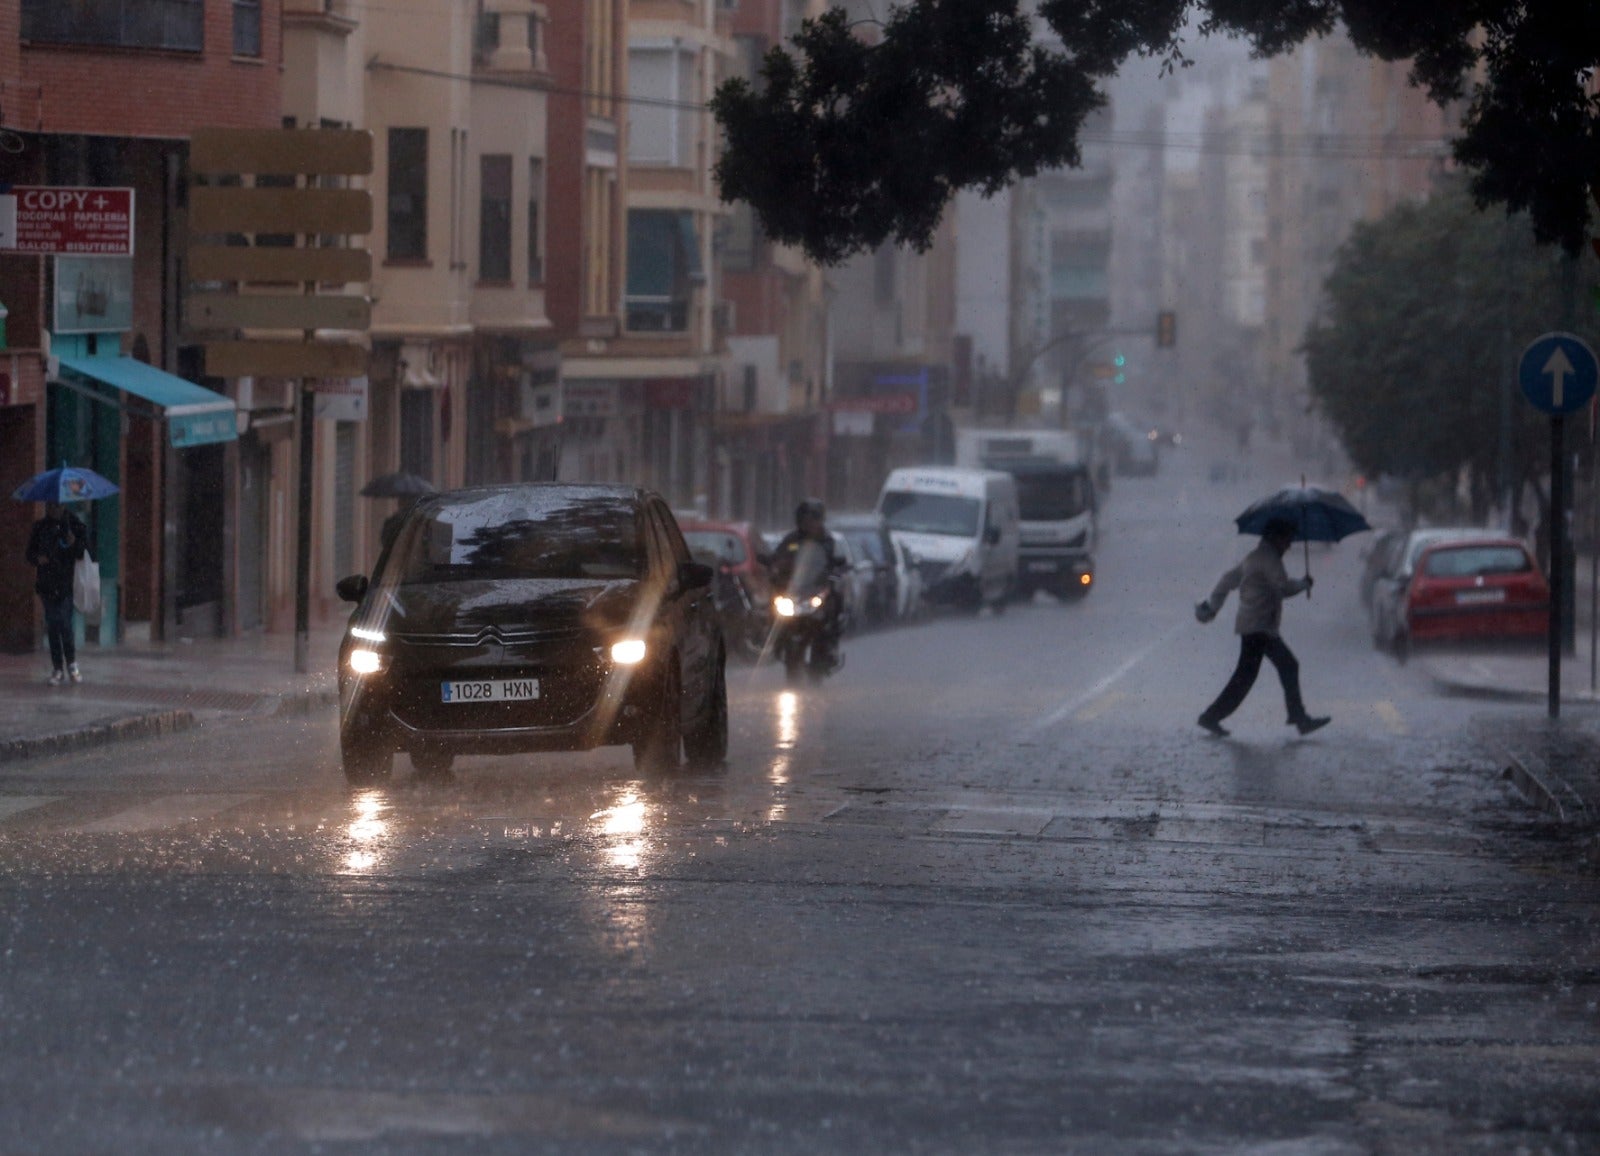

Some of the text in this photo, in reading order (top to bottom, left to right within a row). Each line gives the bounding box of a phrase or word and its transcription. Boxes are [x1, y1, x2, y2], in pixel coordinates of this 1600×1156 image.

[24, 191, 109, 210] COPY +
[455, 682, 533, 699] 1028 HXN
